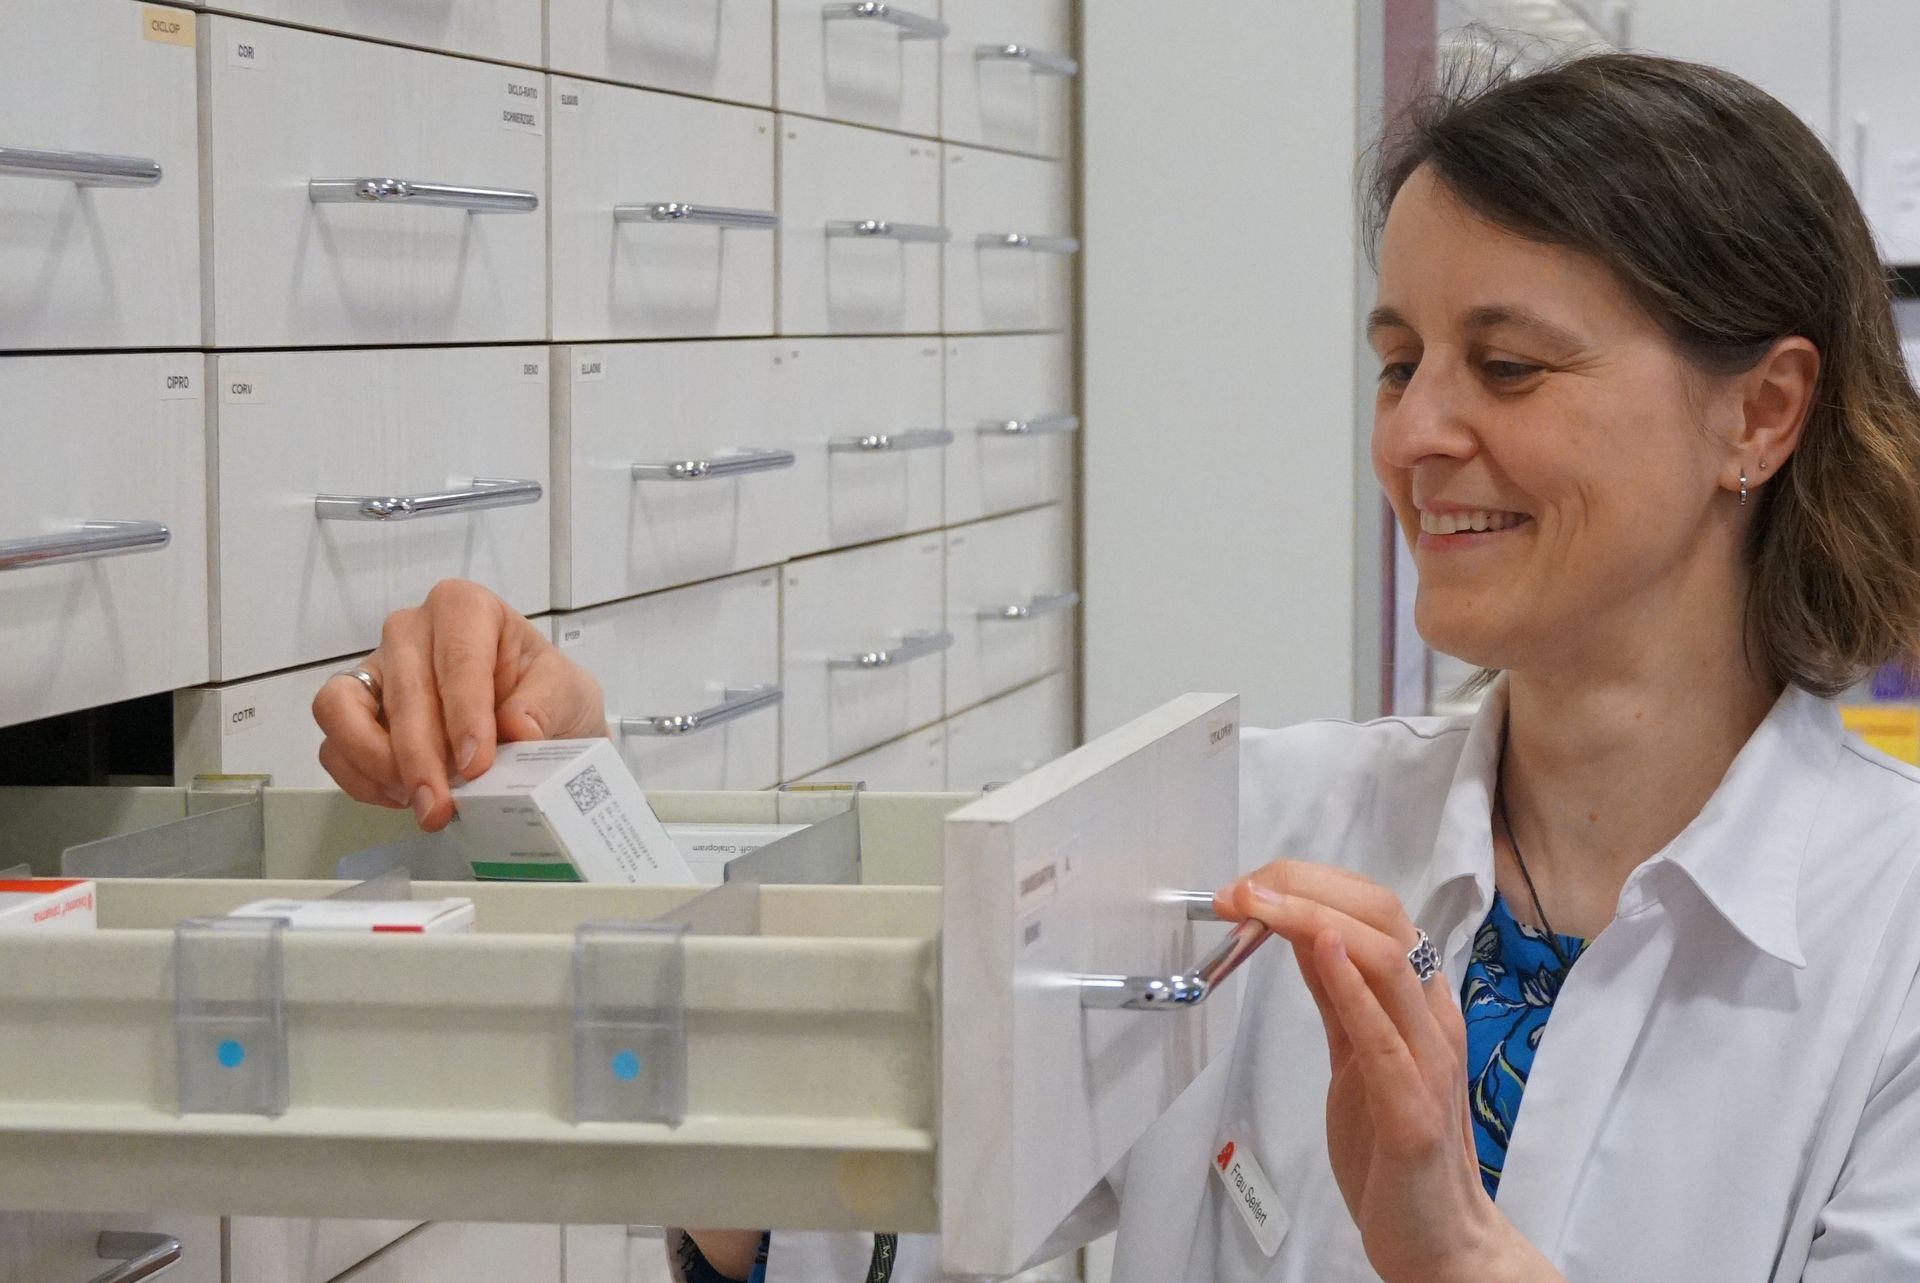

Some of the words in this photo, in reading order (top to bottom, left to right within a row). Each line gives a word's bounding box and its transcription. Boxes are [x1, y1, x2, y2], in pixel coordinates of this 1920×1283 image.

[151, 20, 181, 34] CICLOP
[238, 44, 255, 59] CORI
[166, 375, 189, 389] CIPRO
[231, 383, 253, 395] CORV
[232, 706, 256, 723] COTRI
[692, 844, 737, 854] Citalopram
[1230, 1163, 1247, 1193] Frau
[1244, 1186, 1267, 1227] Seifert
